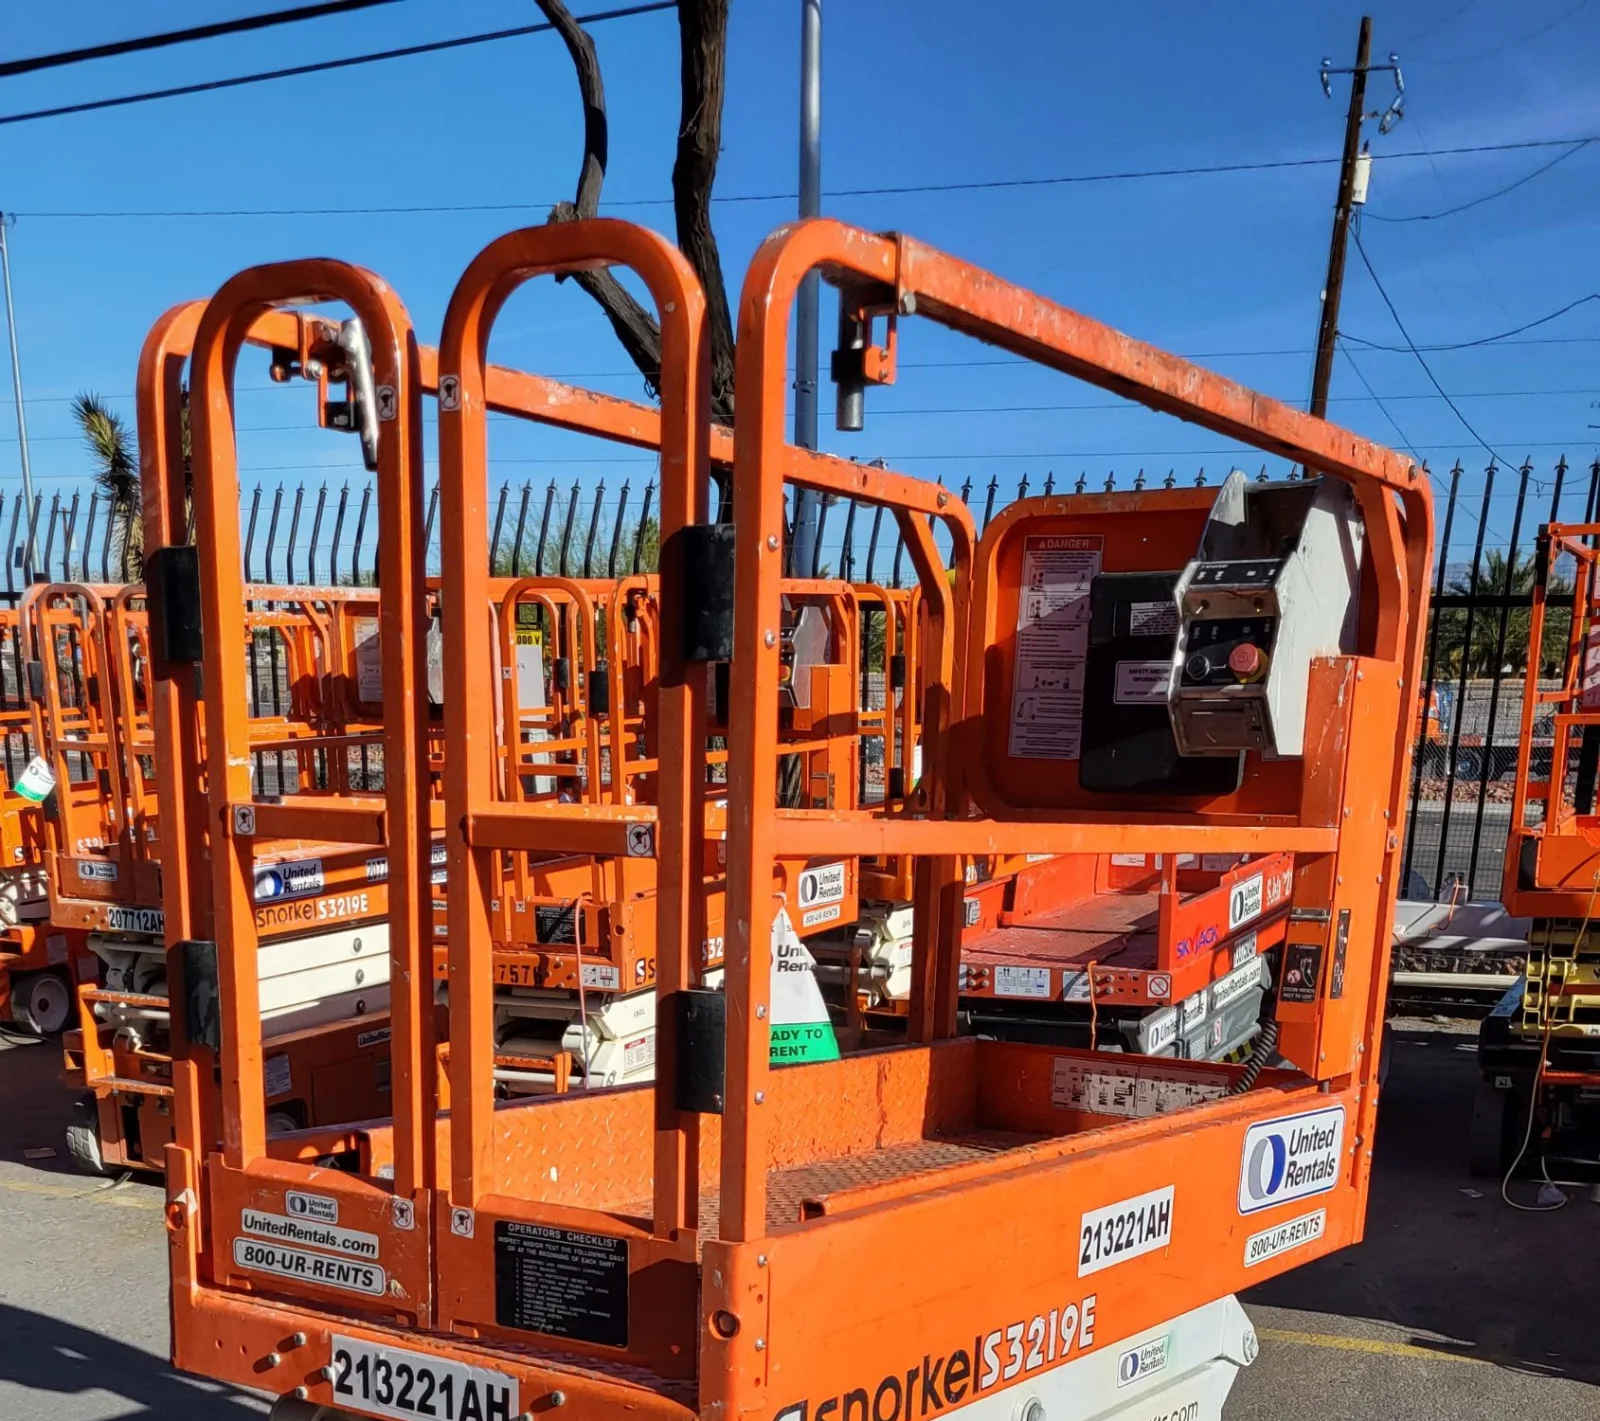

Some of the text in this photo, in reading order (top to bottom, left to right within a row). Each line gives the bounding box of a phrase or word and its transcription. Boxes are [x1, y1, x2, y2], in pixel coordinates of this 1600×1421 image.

[1047, 539, 1090, 549] DANGER
[516, 635, 533, 645] 000
[283, 863, 317, 880] United
[818, 871, 842, 886] United
[283, 879, 321, 894] Rentals
[818, 884, 843, 900] Rentals
[108, 908, 165, 933] 207712AH
[255, 893, 369, 929] snorkel S3219E
[771, 1028, 823, 1042] ADY TO
[770, 1045, 808, 1058] RENT
[1288, 1121, 1337, 1157] United
[1284, 1152, 1336, 1189] Rentals
[308, 1199, 334, 1211] United
[308, 1206, 335, 1220] Rentals
[243, 1214, 376, 1256] UnitedRentals.com
[507, 1223, 618, 1248] OPERATORS CHECKLIST
[1080, 1198, 1171, 1266] 213221AH
[1249, 1215, 1321, 1259] 800-UR-RENTS
[243, 1246, 375, 1287] 800-UR-RENTS
[979, 1293, 1097, 1391] S3219E
[1140, 1340, 1165, 1361] United
[1138, 1354, 1166, 1375] Rentals
